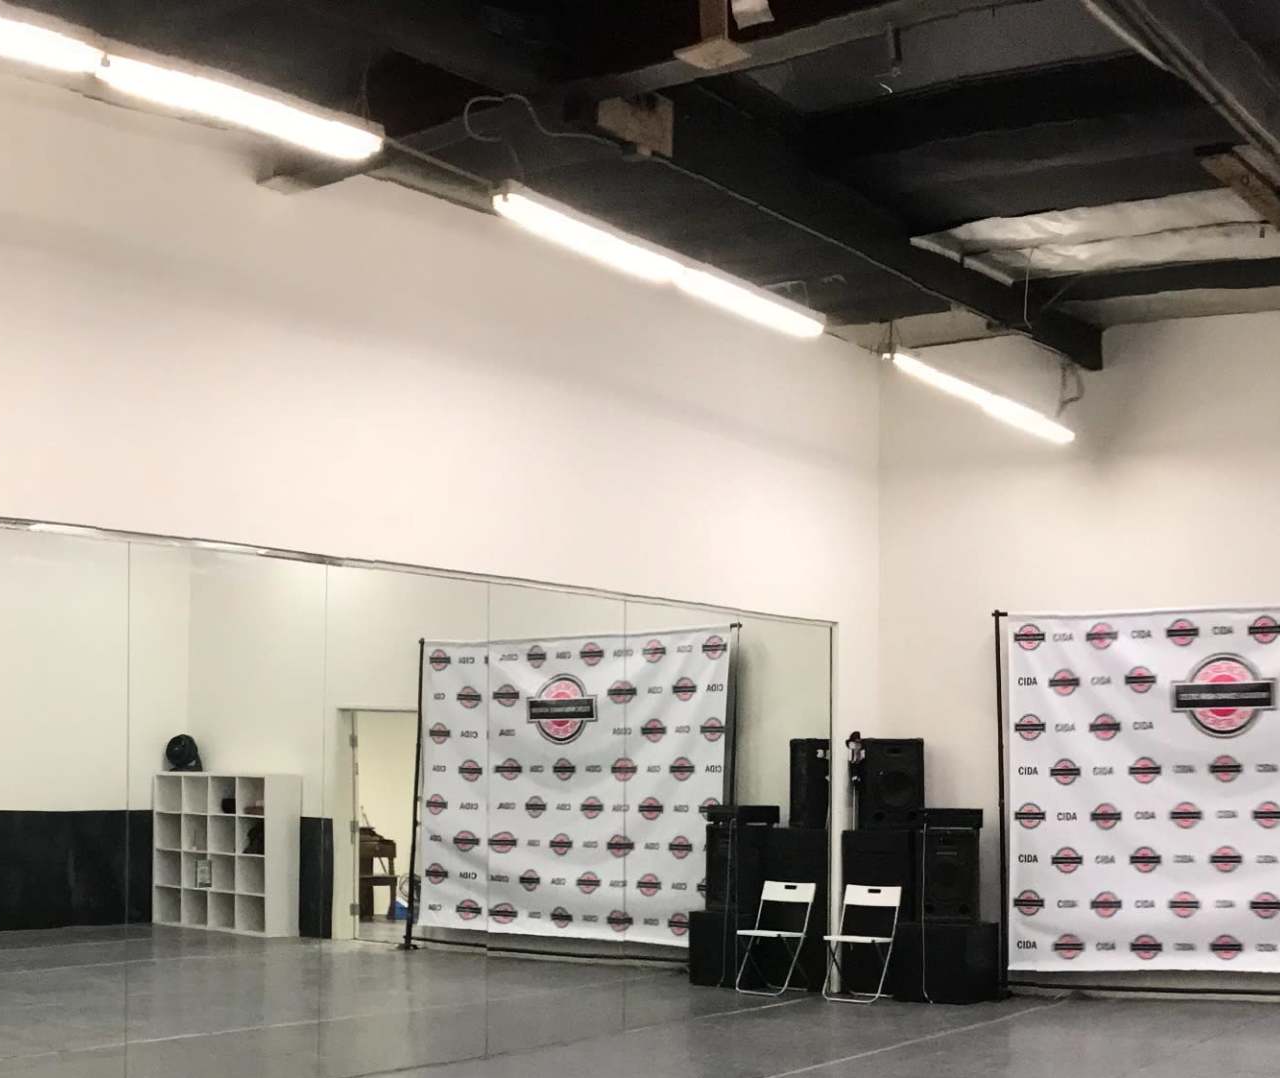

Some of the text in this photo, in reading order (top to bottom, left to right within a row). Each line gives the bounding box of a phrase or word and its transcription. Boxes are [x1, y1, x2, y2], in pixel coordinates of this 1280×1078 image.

[1051, 632, 1074, 643] CIDA
[1130, 629, 1153, 640] CIDA
[1017, 676, 1038, 687] CIDA
[1090, 675, 1113, 686] CIDA
[1132, 721, 1154, 731] CIDA
[1017, 766, 1039, 776] CIDA
[1056, 811, 1078, 822] CIDA
[1017, 853, 1039, 864] CIDA
[1016, 939, 1038, 950] CIDA
